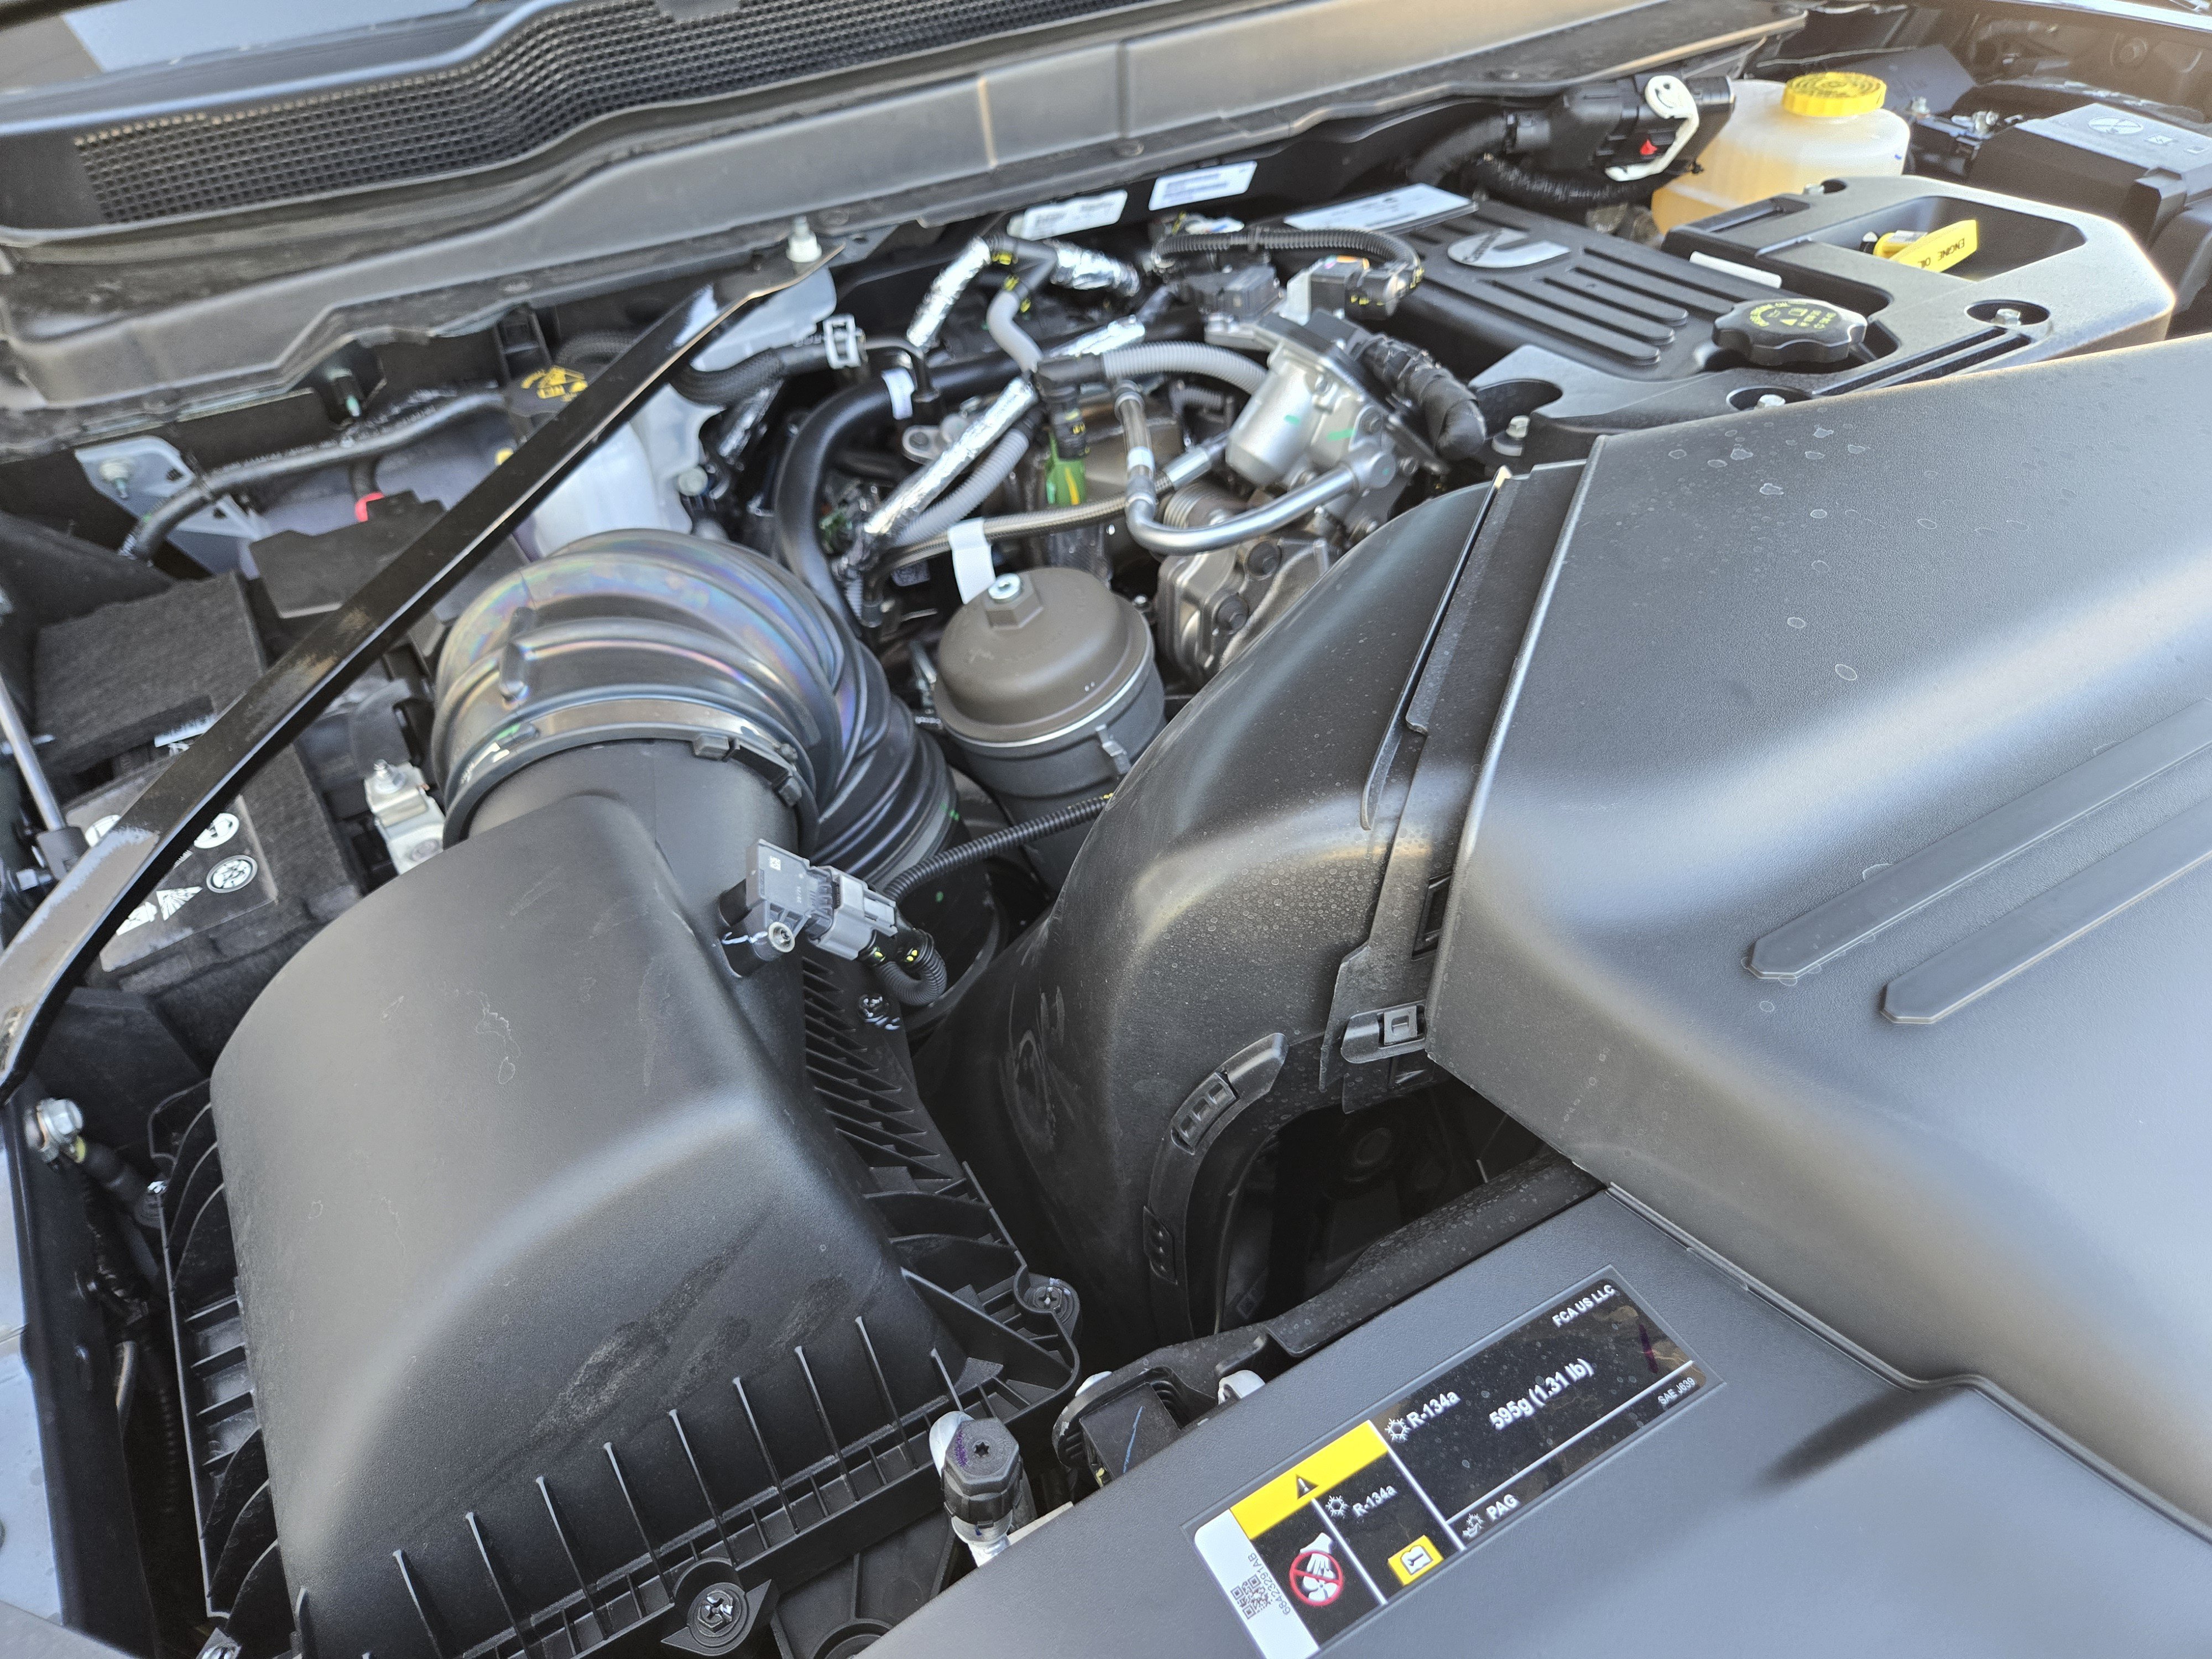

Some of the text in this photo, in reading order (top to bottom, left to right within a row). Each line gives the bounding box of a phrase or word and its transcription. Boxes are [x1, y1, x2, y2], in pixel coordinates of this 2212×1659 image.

[1938, 238, 1964, 261] ENGINE
[1552, 1285, 1615, 1328] FCA US LLC
[1489, 1358, 1594, 1430] 595g (1.31 lb)
[1657, 1377, 1695, 1405] SAE J639
[1406, 1391, 1460, 1428] R-134a
[1353, 1485, 1397, 1517] R-134a
[1486, 1494, 1519, 1520] PAG
[1248, 1552, 1291, 1615] 68423291AB
